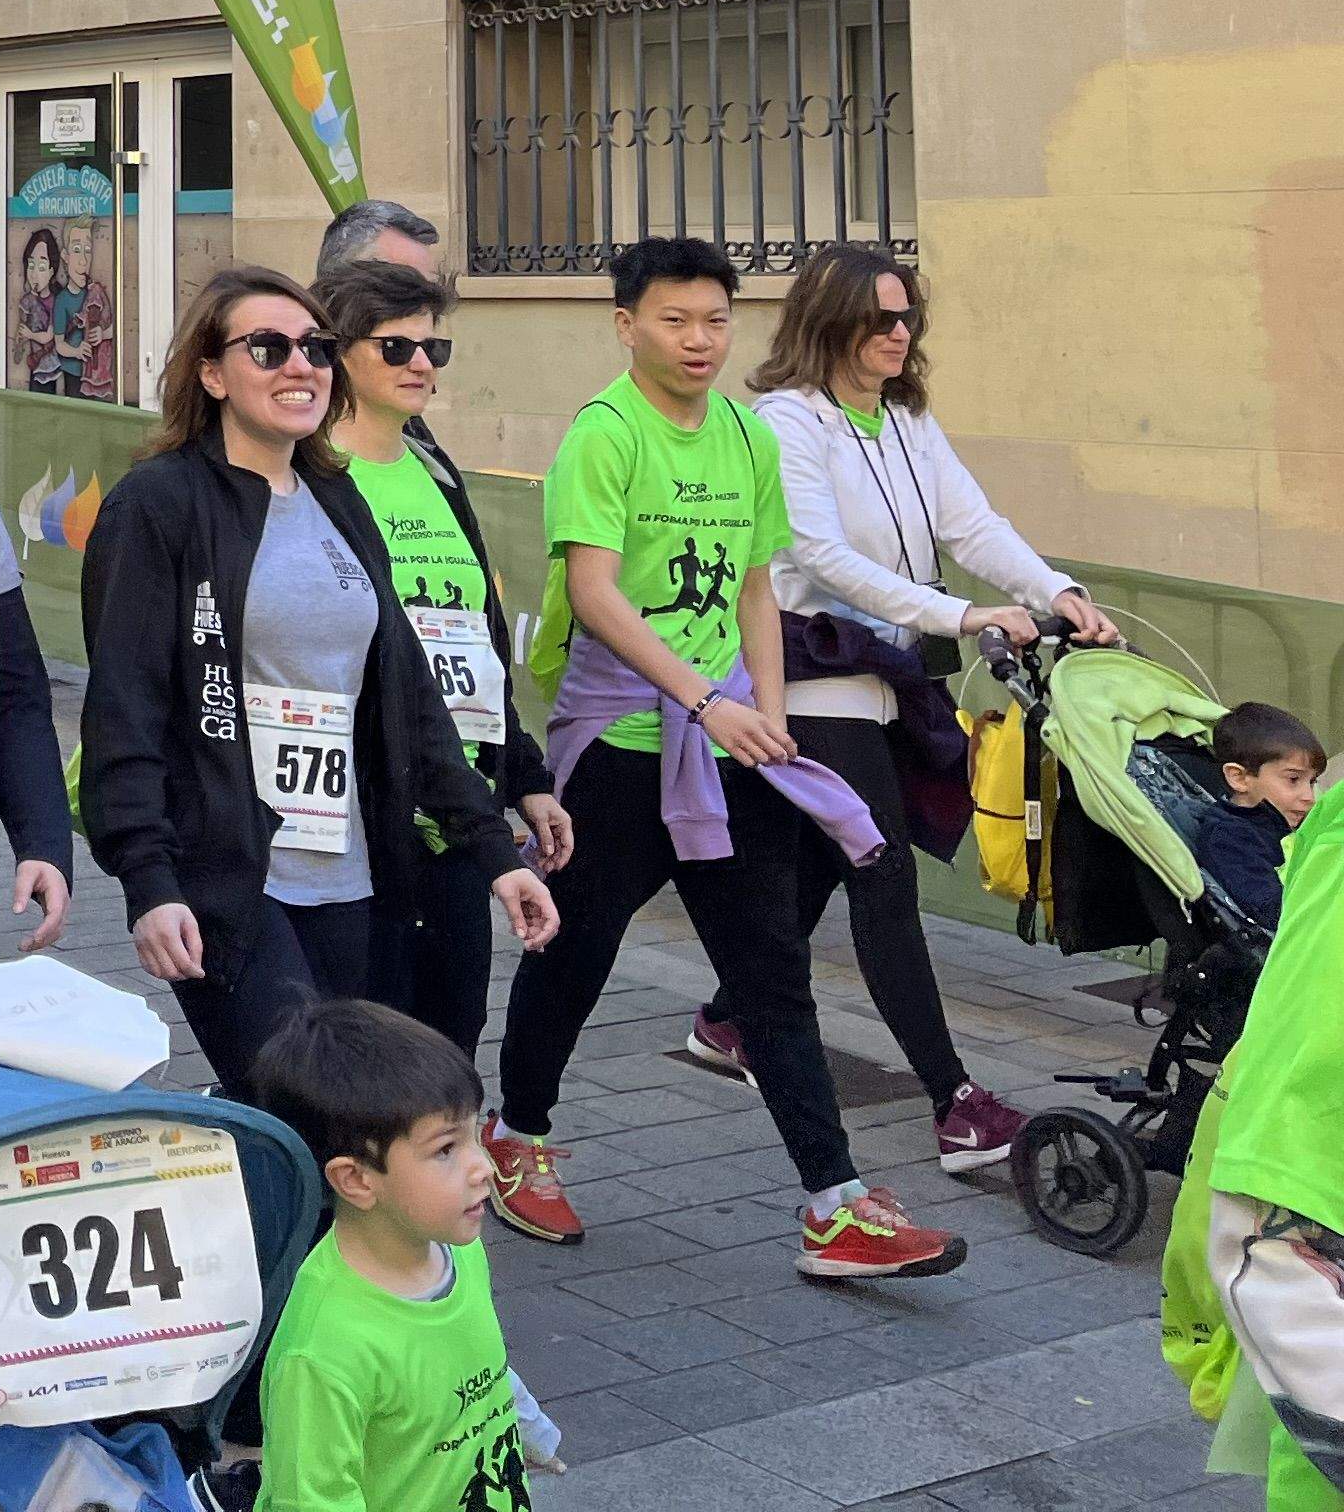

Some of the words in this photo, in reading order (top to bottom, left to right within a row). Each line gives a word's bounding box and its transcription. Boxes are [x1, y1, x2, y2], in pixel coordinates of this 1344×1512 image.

[21, 166, 65, 206] ESCUELA
[67, 172, 77, 187] DE
[80, 168, 113, 205] GAITA
[39, 196, 96, 215] ARAGONESA
[637, 513, 651, 522] EN
[702, 518, 717, 527] LA
[411, 555, 429, 565] POR
[432, 555, 443, 564] LA
[194, 609, 223, 629] HUES
[433, 653, 476, 697] 65
[275, 743, 347, 799] 578
[166, 1143, 222, 1158] IBERDROLA
[21, 1207, 185, 1319] 324
